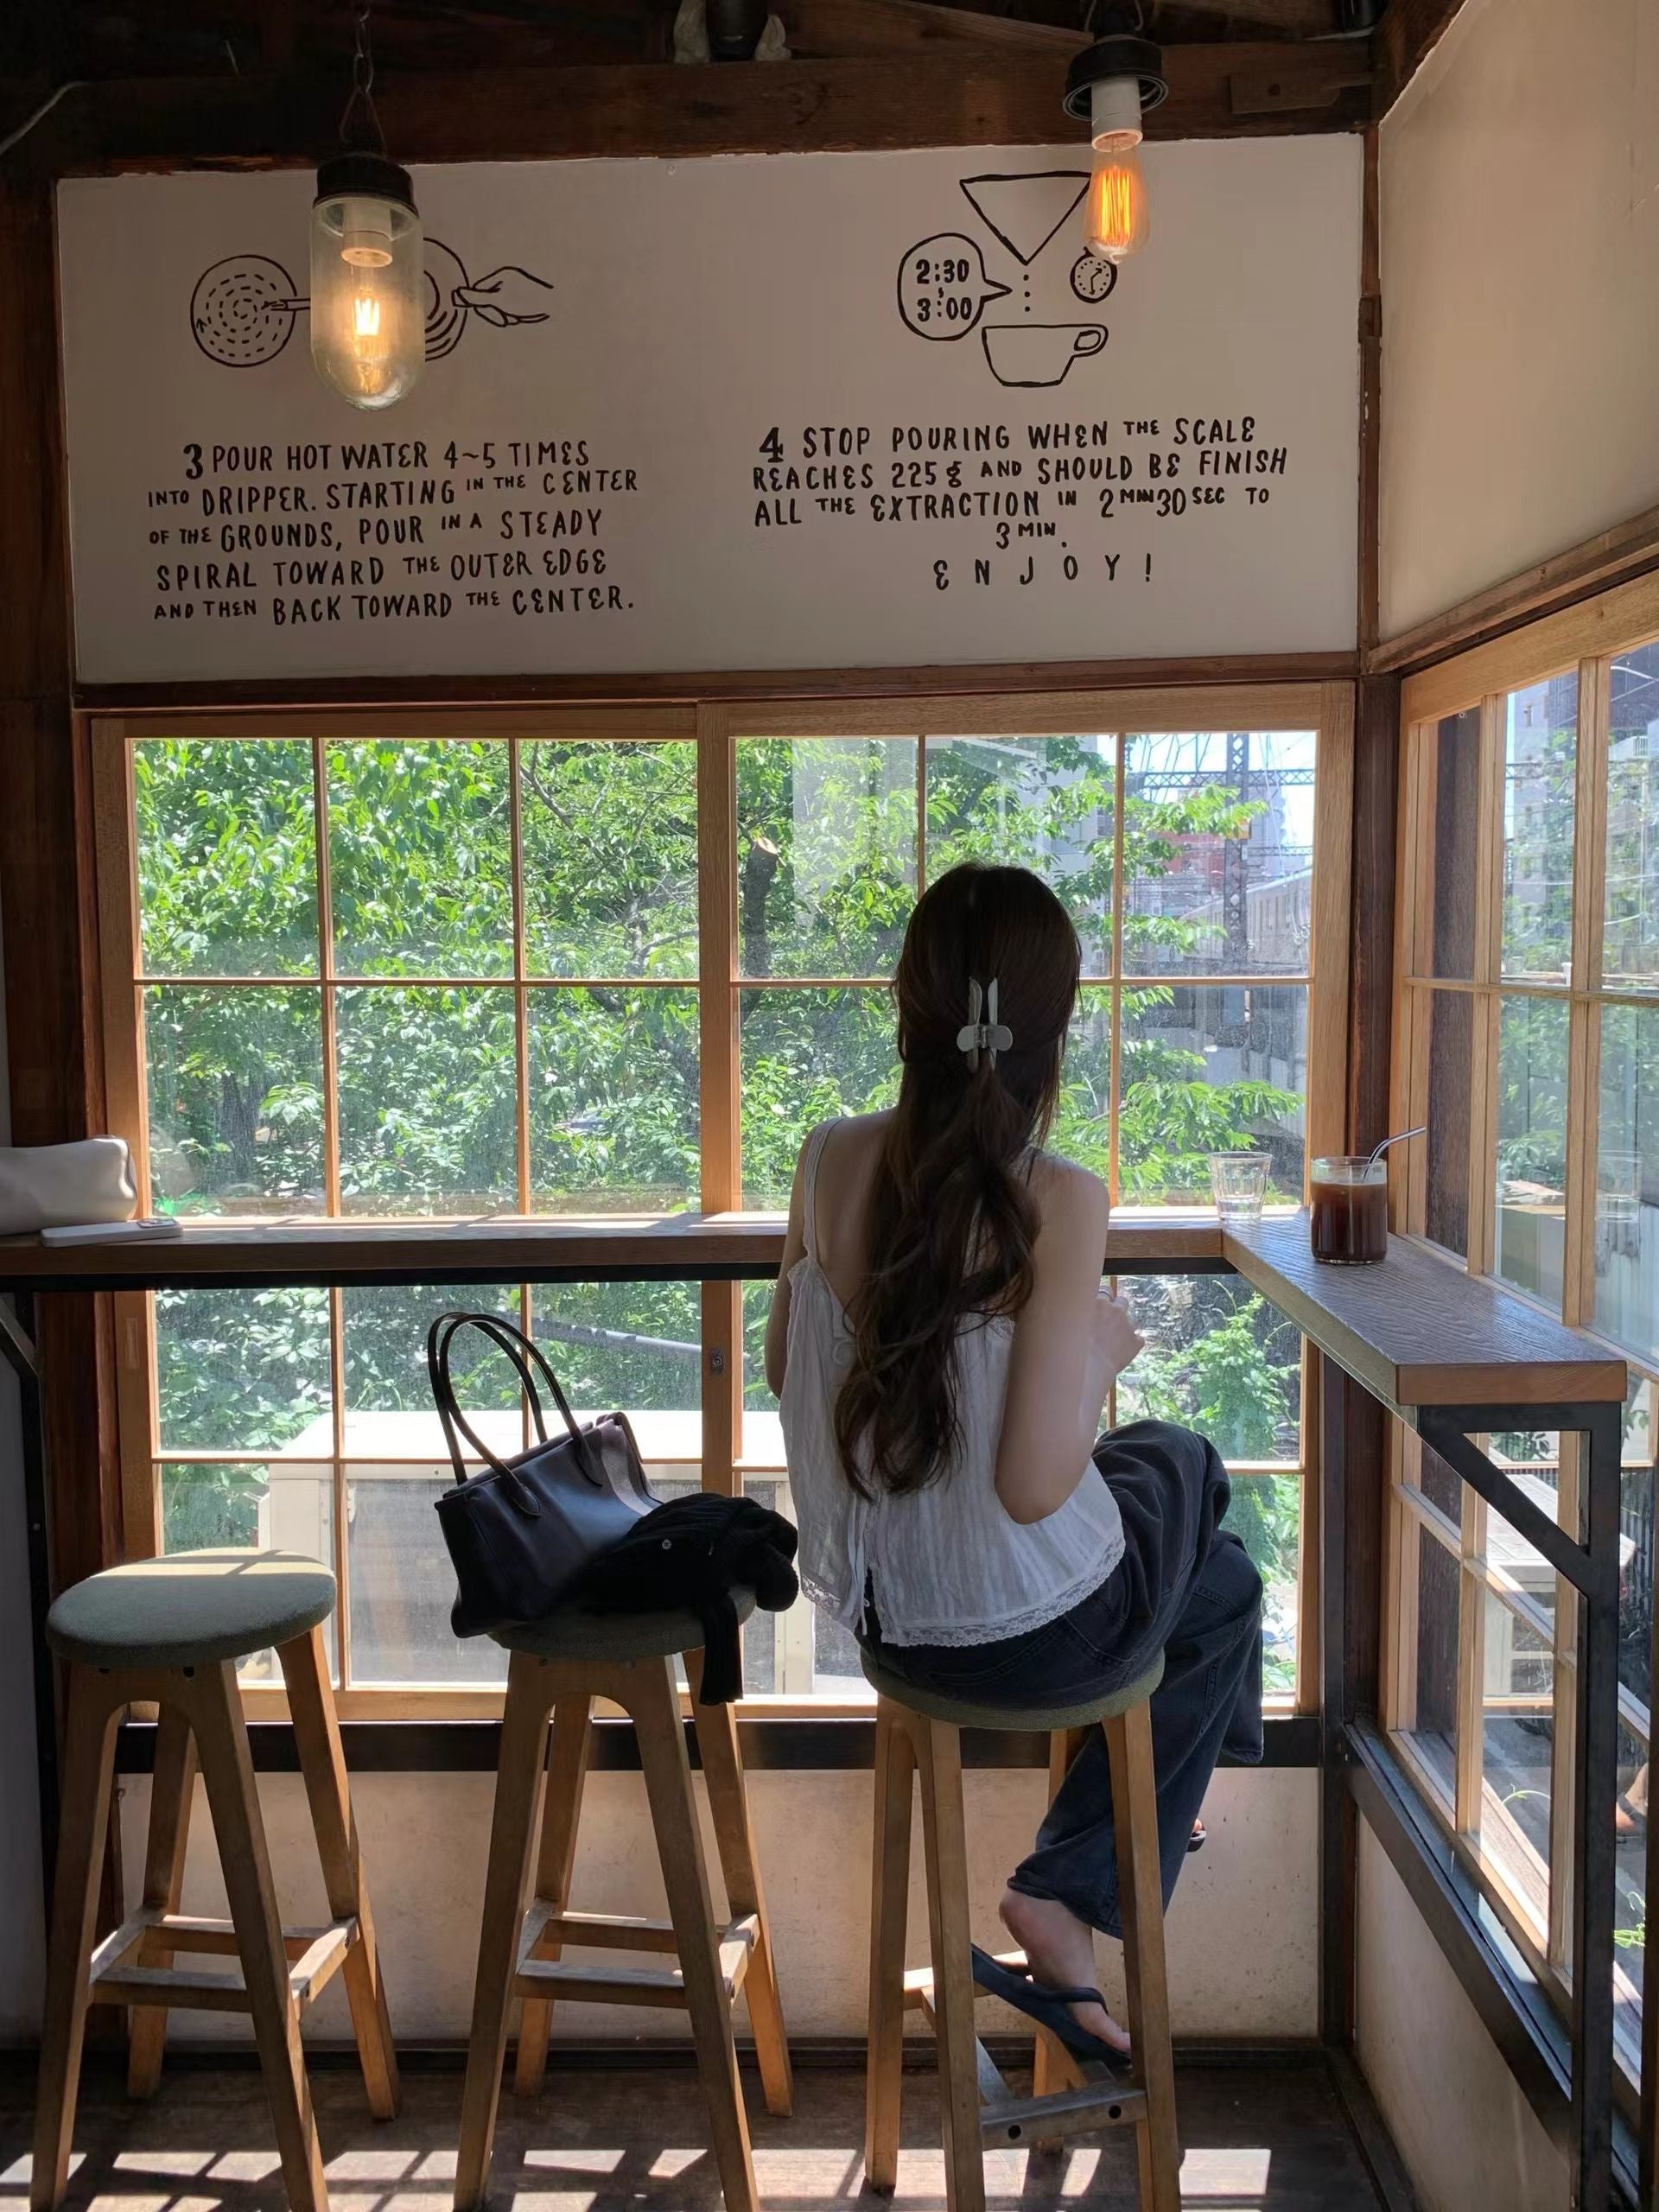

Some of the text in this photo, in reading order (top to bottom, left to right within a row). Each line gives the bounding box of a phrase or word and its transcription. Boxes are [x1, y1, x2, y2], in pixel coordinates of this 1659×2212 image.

[915, 258, 970, 285] 2:30
[916, 296, 973, 323] 3:00
[183, 443, 204, 480] 3
[213, 445, 273, 474] POUR
[287, 444, 333, 472] HOT
[340, 441, 429, 471] WATER
[507, 440, 589, 468] TIMES
[759, 416, 1255, 464] 4 STOP POURING WHEN THE SCALE
[753, 462, 874, 493] REACHES
[980, 459, 1022, 478] AND
[1037, 454, 1133, 486] SHOULD
[1148, 452, 1181, 480] BE
[1198, 447, 1287, 476] FINISH
[148, 468, 638, 517] INTO DRIPPER. STARTING IN THE CENTER
[754, 498, 803, 528] ALL
[814, 496, 856, 516] THE
[869, 490, 1039, 523] EXTRACTION
[1058, 490, 1077, 506] IN
[1244, 486, 1270, 505] TO
[149, 508, 602, 553] OF THE GROUNDS, POUR IN A STEADY
[156, 548, 607, 592] SPIRAL TOWARD THE OUTER EDGE
[154, 585, 634, 626] AND THEN BACK TOWARD THE CENTER.
